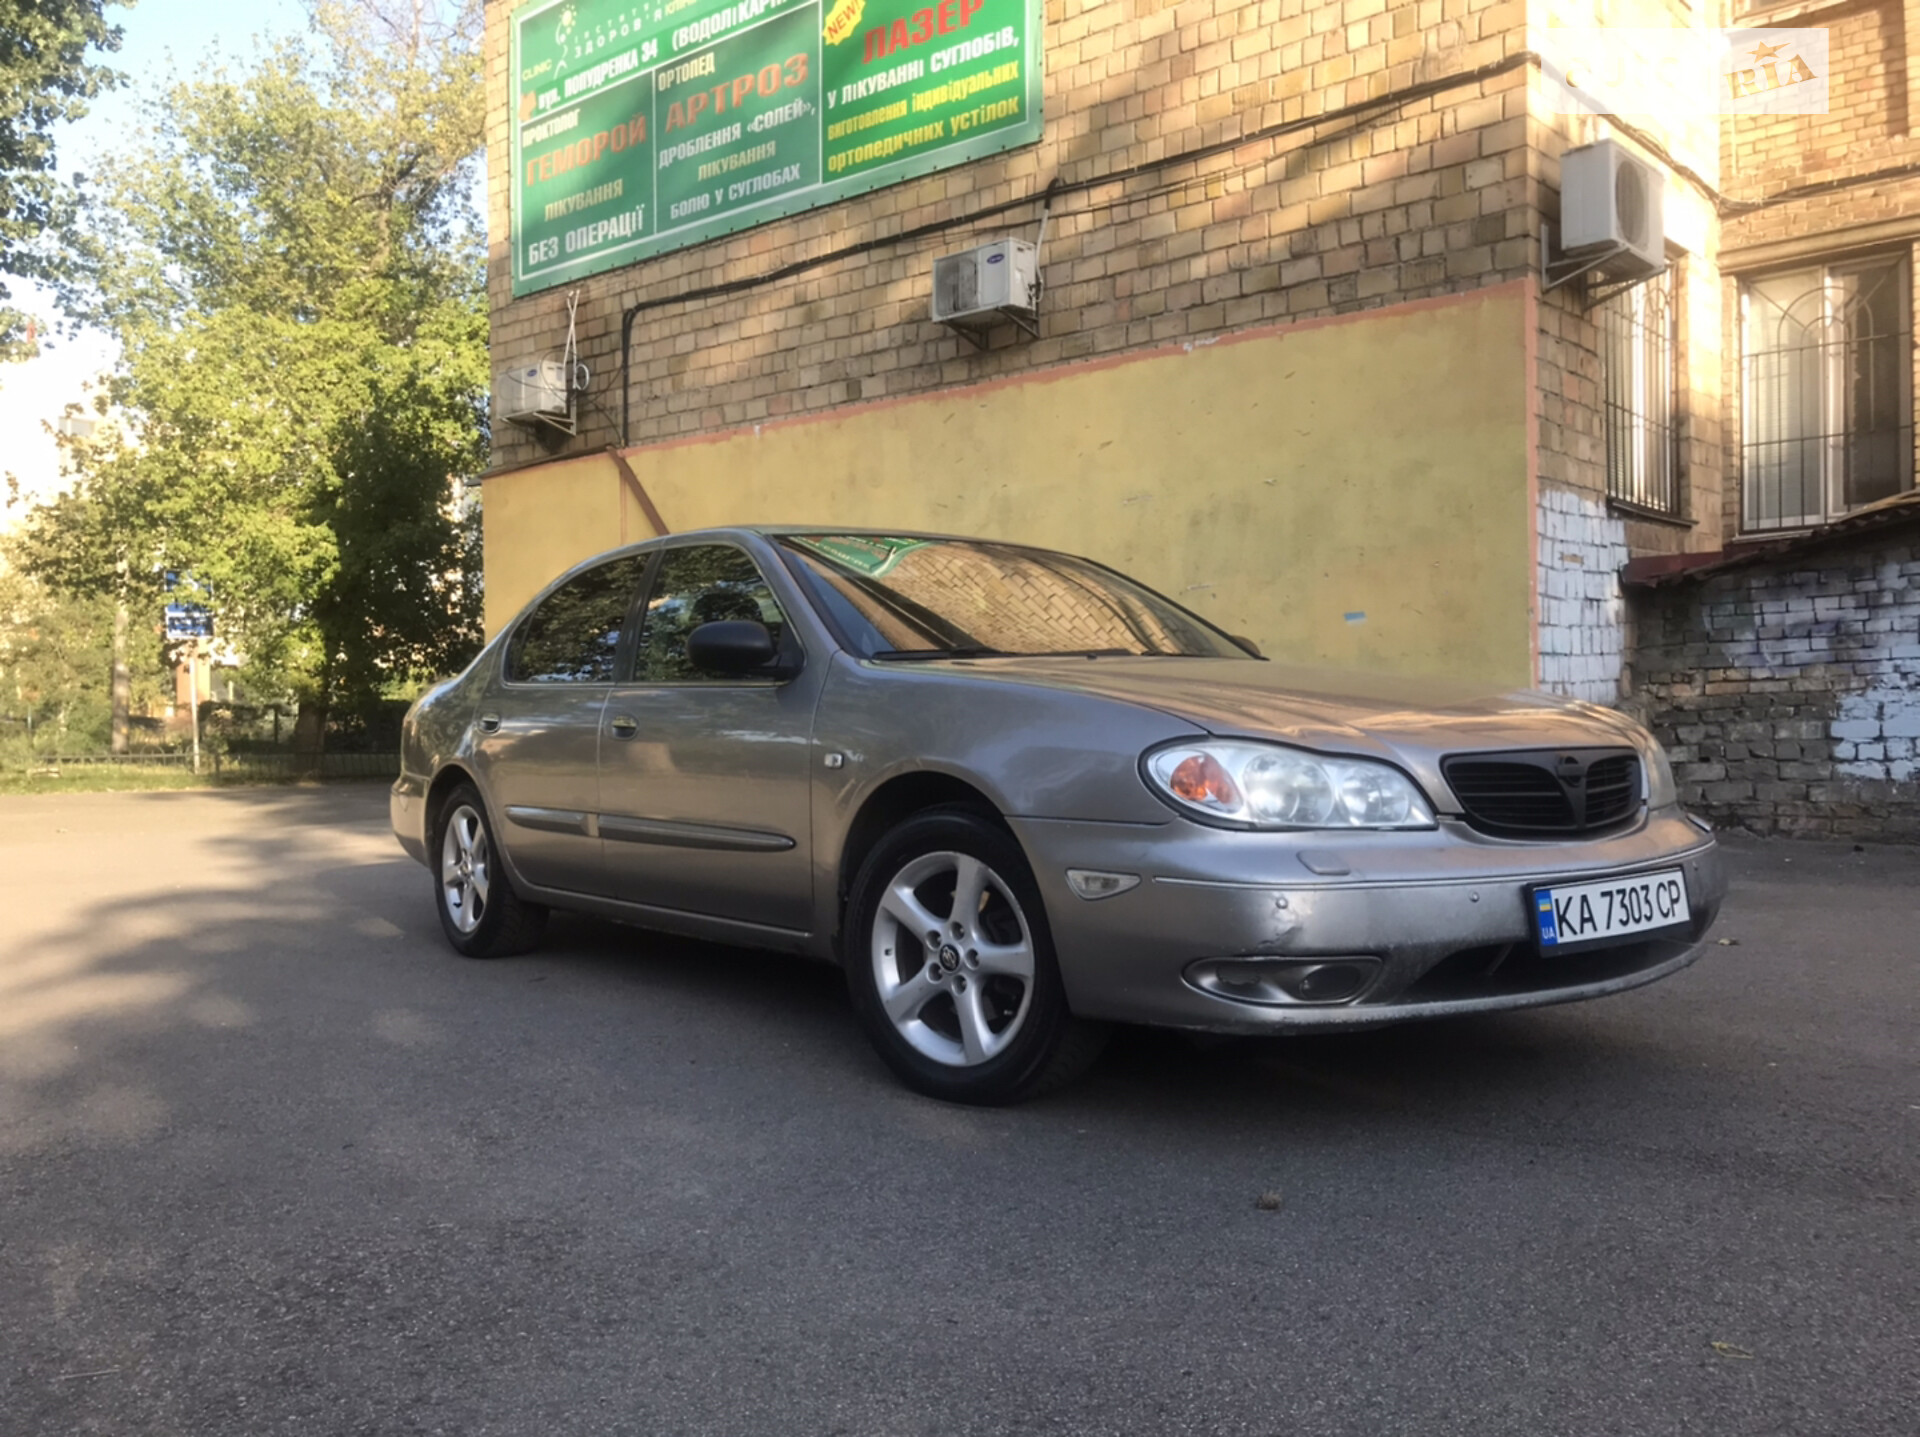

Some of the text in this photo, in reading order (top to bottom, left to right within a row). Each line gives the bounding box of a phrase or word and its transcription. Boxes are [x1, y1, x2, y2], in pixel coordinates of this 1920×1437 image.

[862, 0, 985, 65] ЛАЗЕР
[657, 51, 716, 92] ОРТОПЕД
[664, 52, 809, 134] АРТРОЗ
[841, 58, 925, 105] ЛІКУВАННІ
[929, 25, 1020, 73] СУГЛОБІВ,
[827, 60, 1019, 141] виготовлення індивідуальних
[526, 112, 648, 187] ГЕМОРОЙ
[658, 121, 742, 170] ДРОБЛЕННЯ
[697, 139, 777, 182] ЛІКУВАННЯ
[827, 95, 1019, 173] ортопедичних устілок
[544, 178, 624, 222] ЛІКУВАННЯ
[669, 192, 711, 221] БОЛЮ
[728, 162, 801, 202] СУГЛОБАХ
[528, 203, 646, 266] БЕЗ ОПЕРАЦІЇ
[1542, 927, 1556, 939] UA
[1554, 879, 1681, 938] KA 7303 CP
